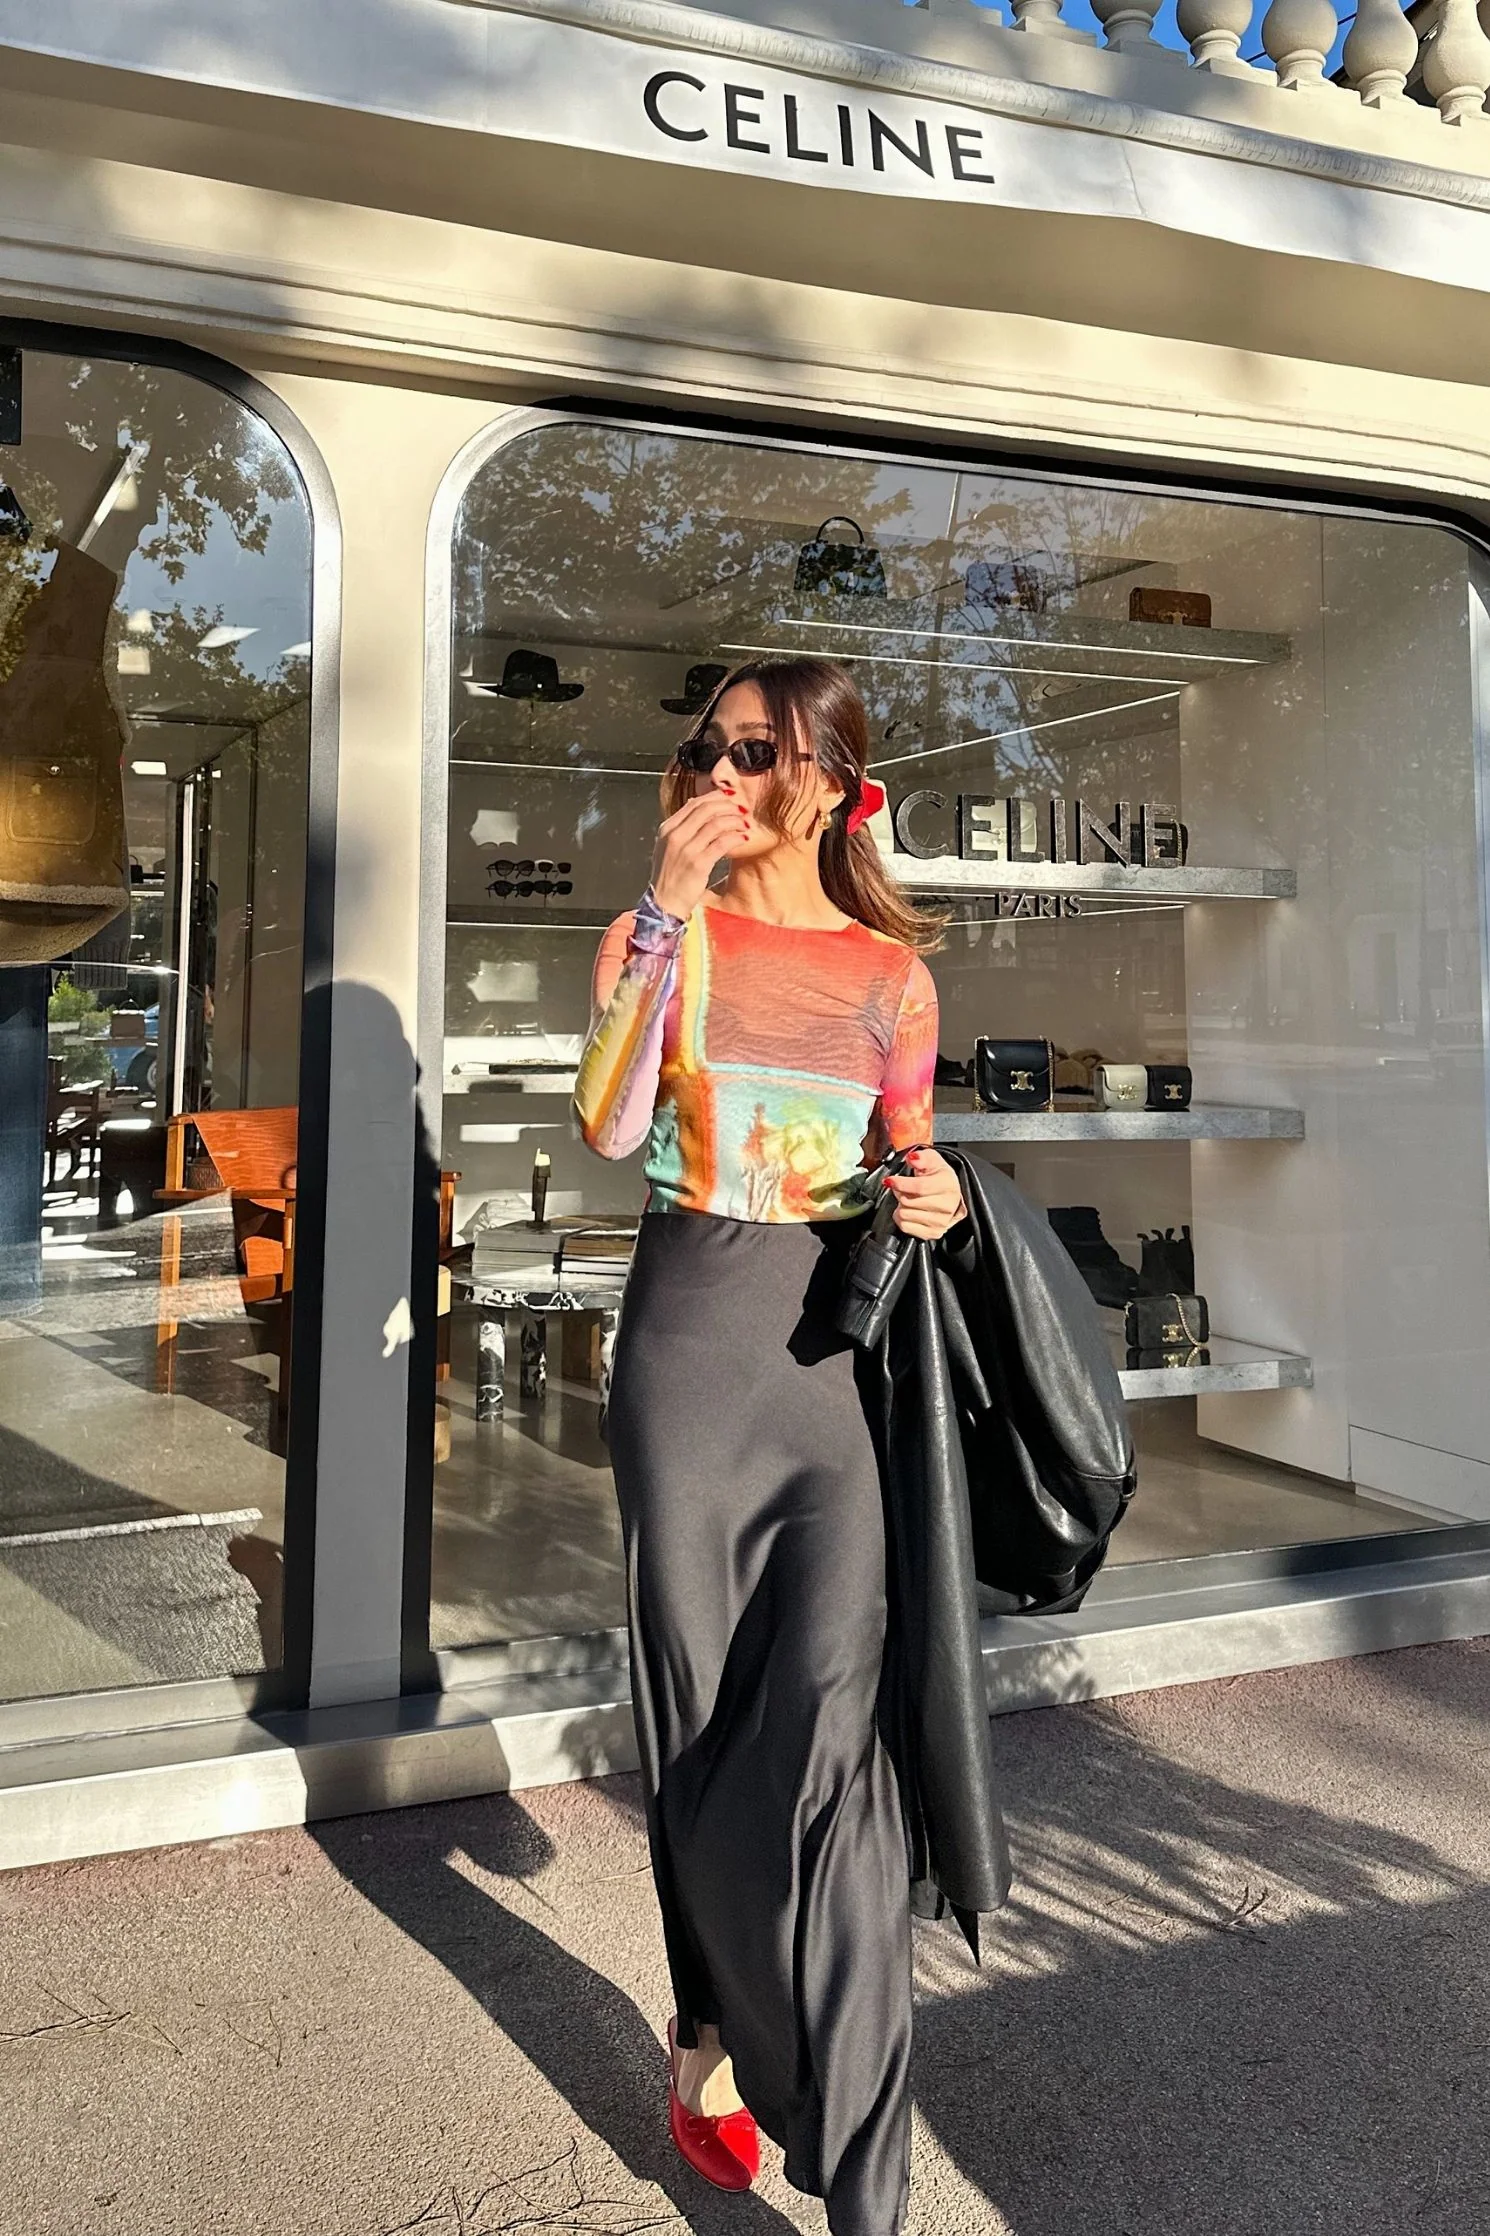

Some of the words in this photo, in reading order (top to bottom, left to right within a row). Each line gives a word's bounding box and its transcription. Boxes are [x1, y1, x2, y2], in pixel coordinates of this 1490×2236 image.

[643, 71, 995, 184] CELINE
[894, 789, 1182, 869] CELINE
[995, 891, 1084, 919] PARIS
